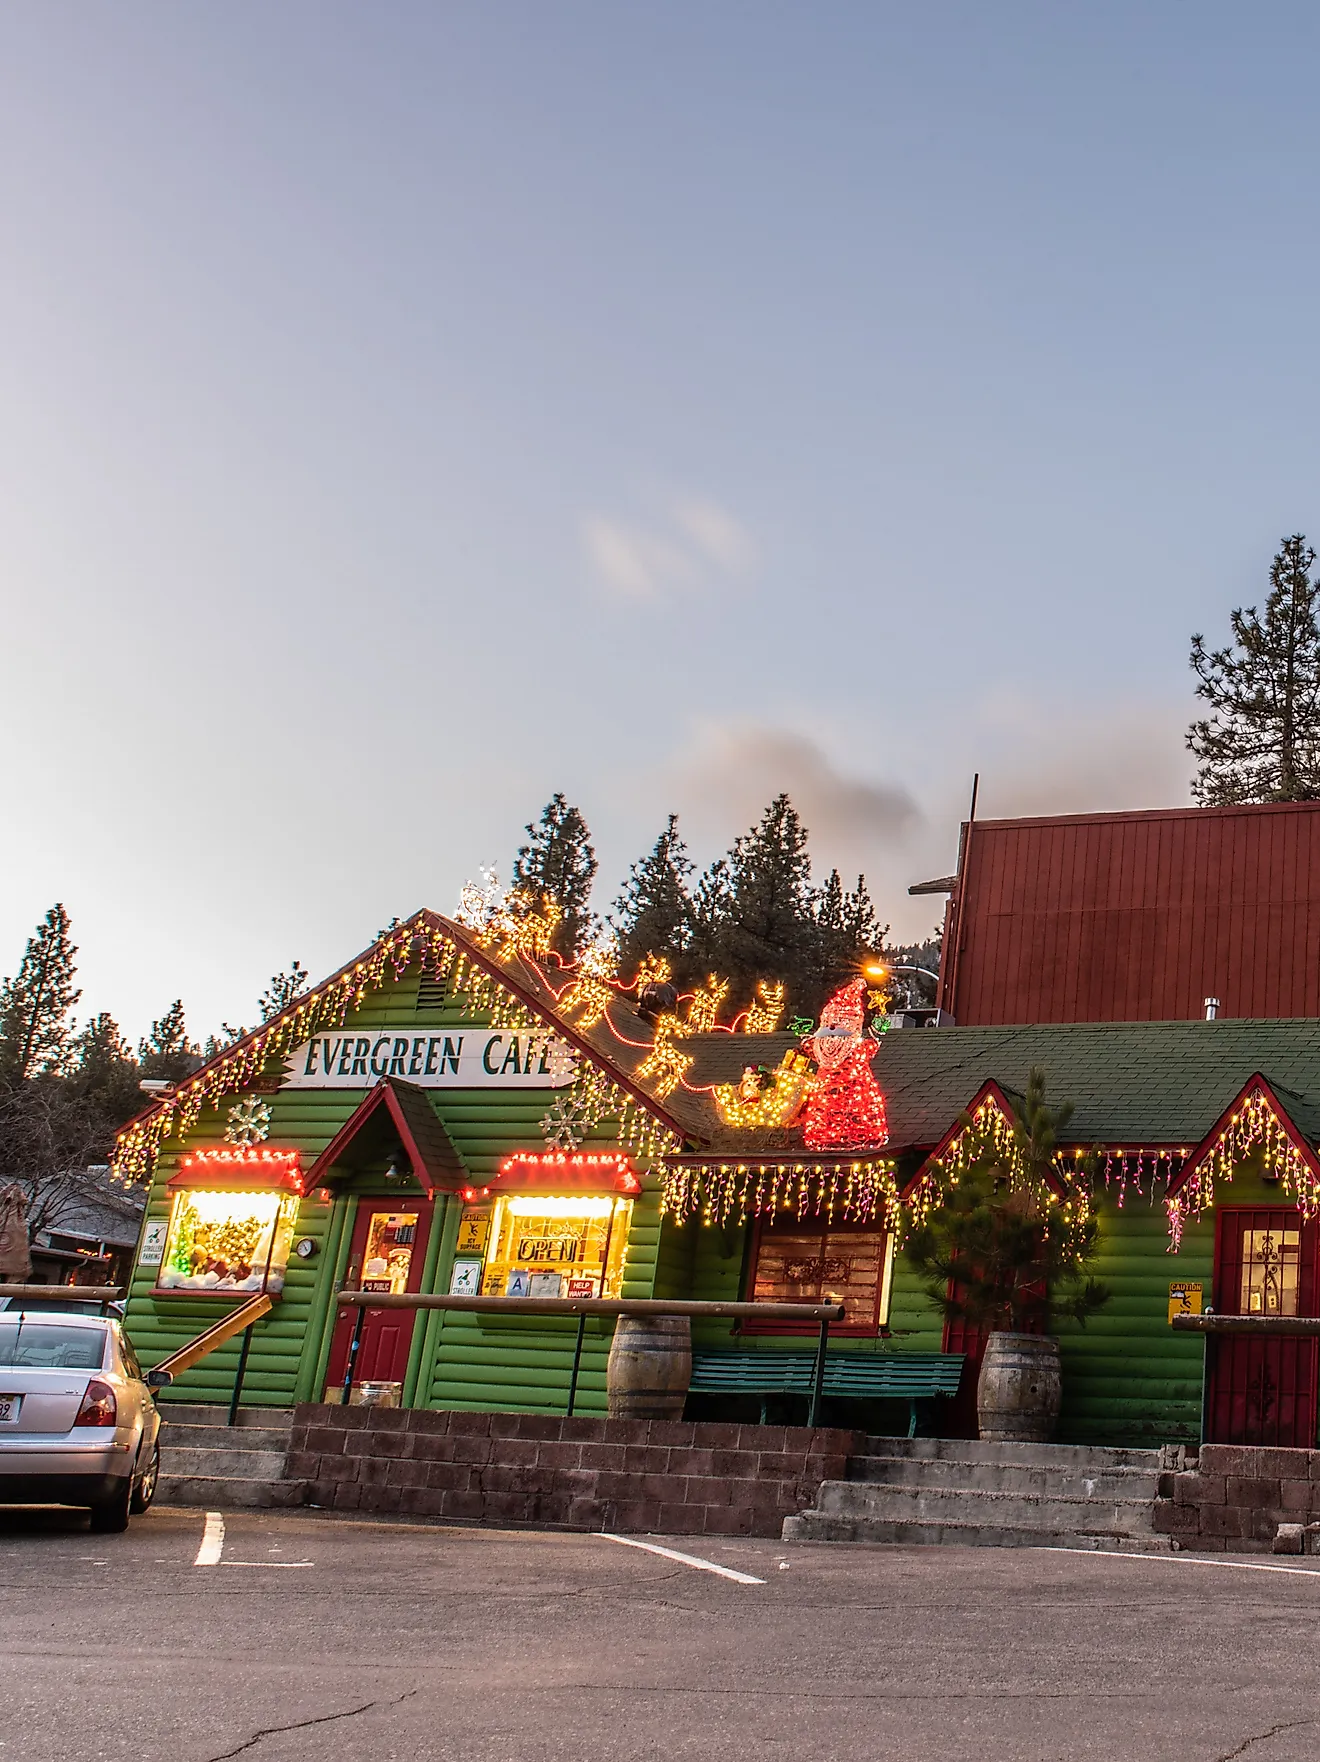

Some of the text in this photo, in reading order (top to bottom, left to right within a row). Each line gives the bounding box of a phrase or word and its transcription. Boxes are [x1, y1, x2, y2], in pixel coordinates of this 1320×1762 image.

[303, 1034, 557, 1076] EVERGREEN CAFE
[518, 1238, 577, 1262] OPEN
[373, 1282, 390, 1291] PUBLIC
[512, 1277, 522, 1290] A
[573, 1281, 590, 1289] HELP
[452, 1287, 474, 1295] STROLLER
